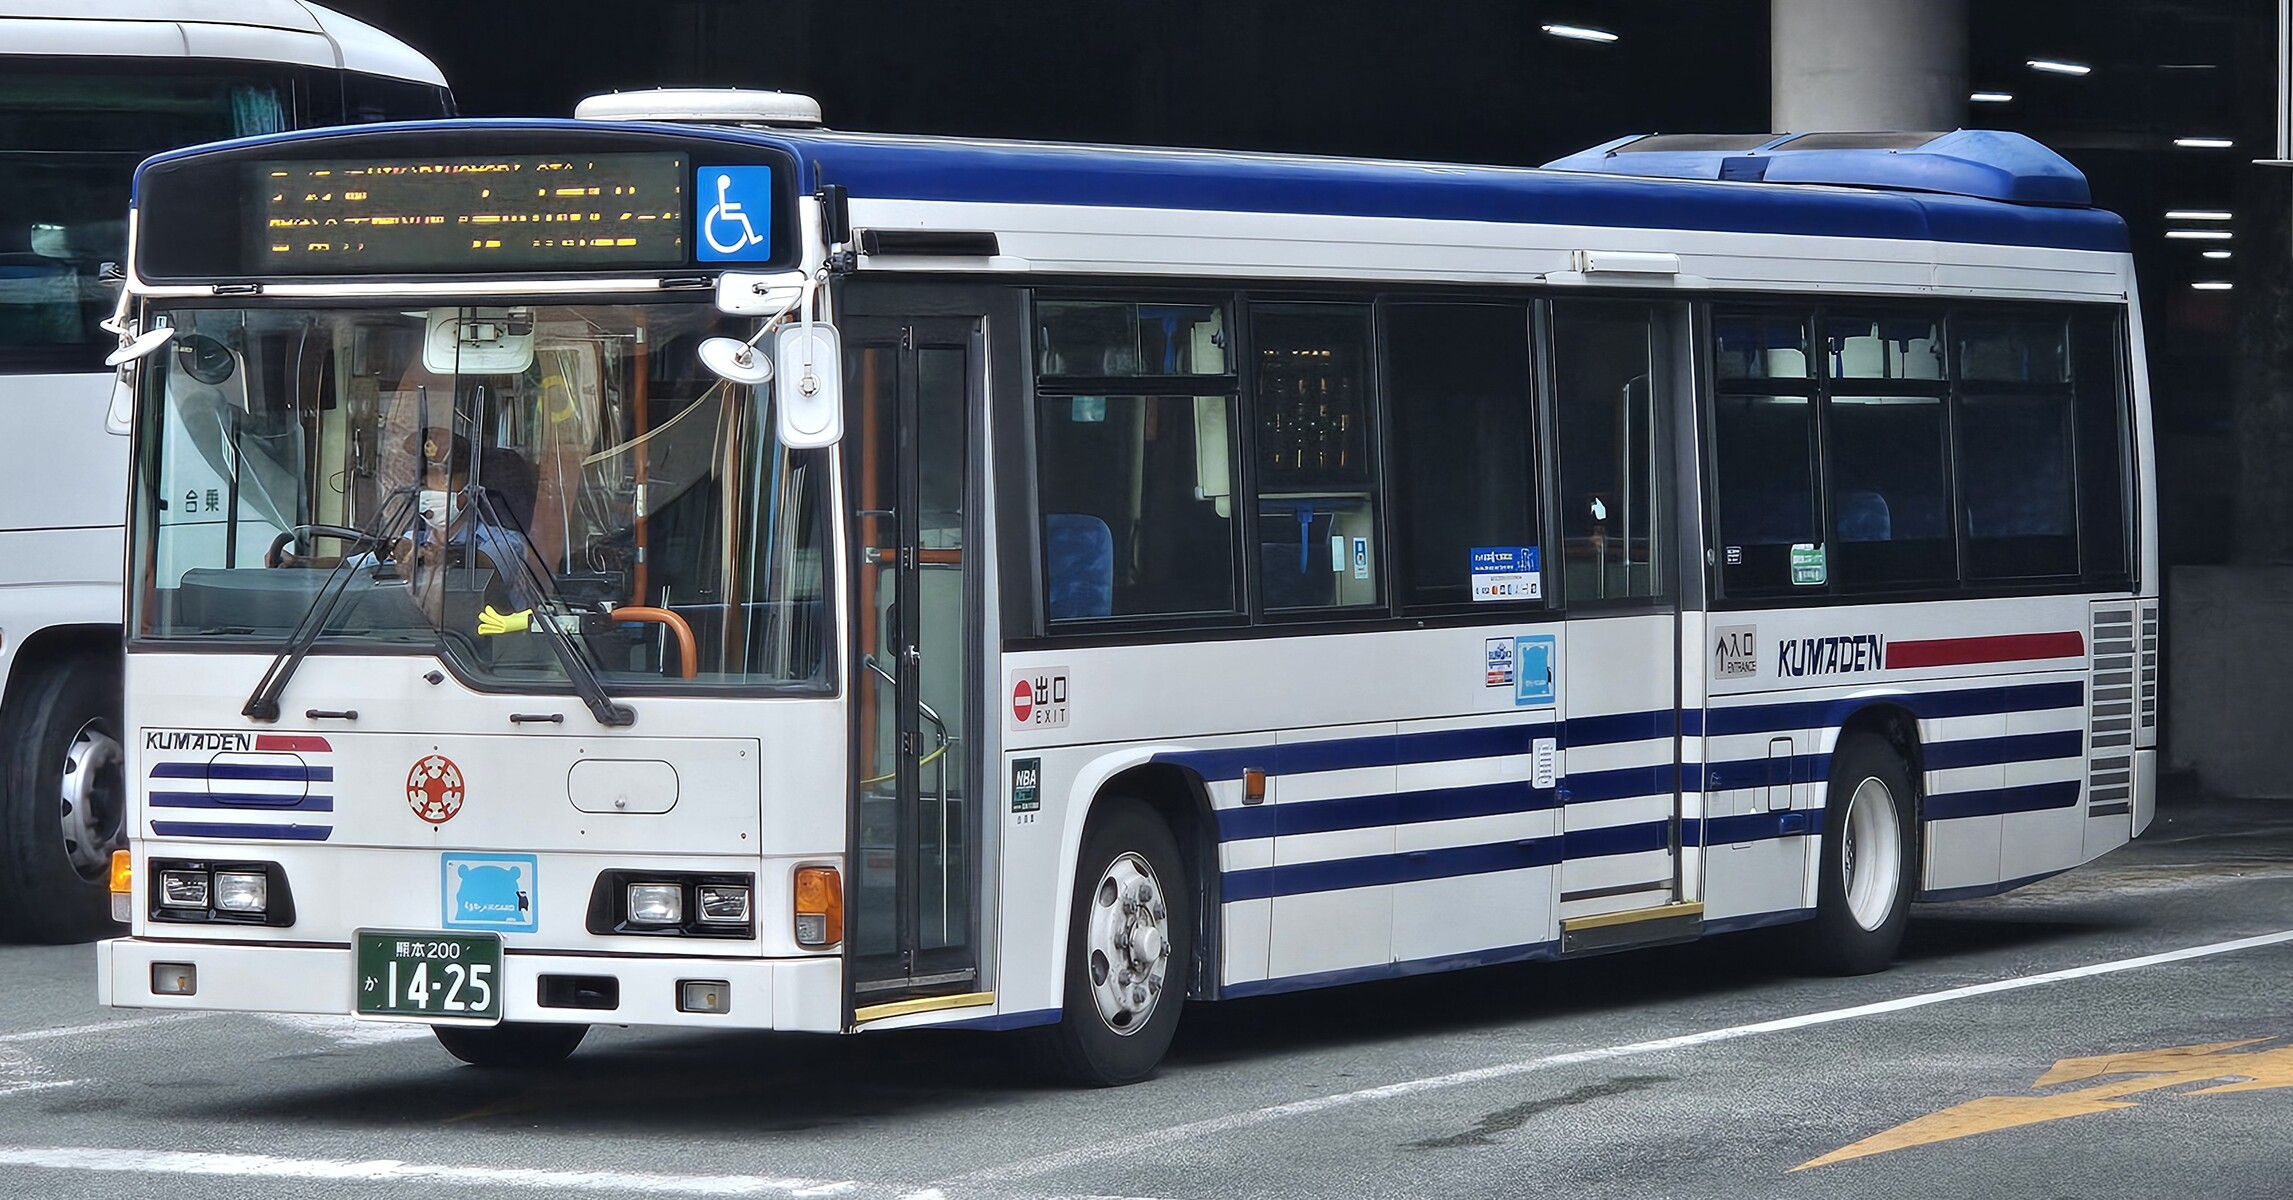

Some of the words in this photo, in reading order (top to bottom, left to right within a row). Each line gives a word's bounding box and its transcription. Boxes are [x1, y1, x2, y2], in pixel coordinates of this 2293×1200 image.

[1730, 633, 1753, 657] 入口
[1778, 633, 1884, 678] KUMADEN
[1727, 660, 1757, 674] ENTRANCE
[1035, 676, 1067, 705] 出口
[1036, 708, 1066, 724] EXIT
[146, 731, 252, 752] KUMADEN
[1015, 769, 1037, 787] NBA
[364, 975, 379, 992] か
[388, 961, 492, 1012] 14-25
